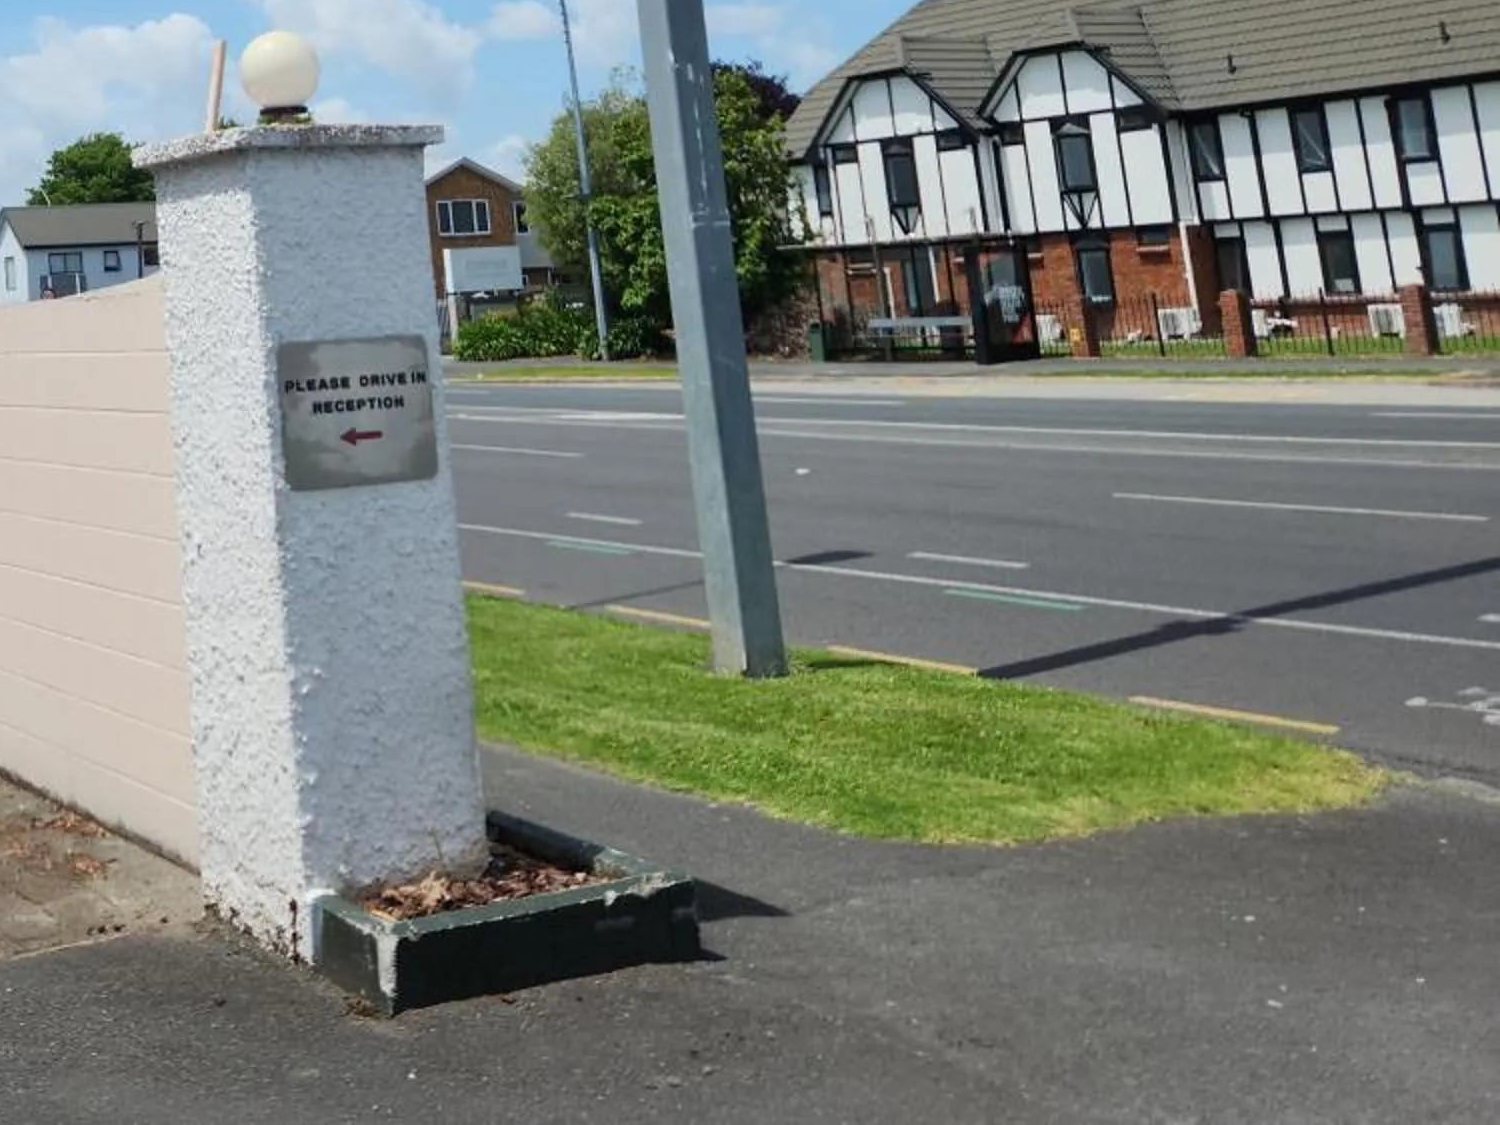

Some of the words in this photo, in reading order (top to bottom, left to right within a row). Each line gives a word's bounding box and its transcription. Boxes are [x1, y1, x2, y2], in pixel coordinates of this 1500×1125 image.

[284, 376, 351, 394] PLEASE
[359, 373, 407, 387] DRIVE
[411, 371, 427, 383] IN
[312, 395, 405, 415] RECEPTION
